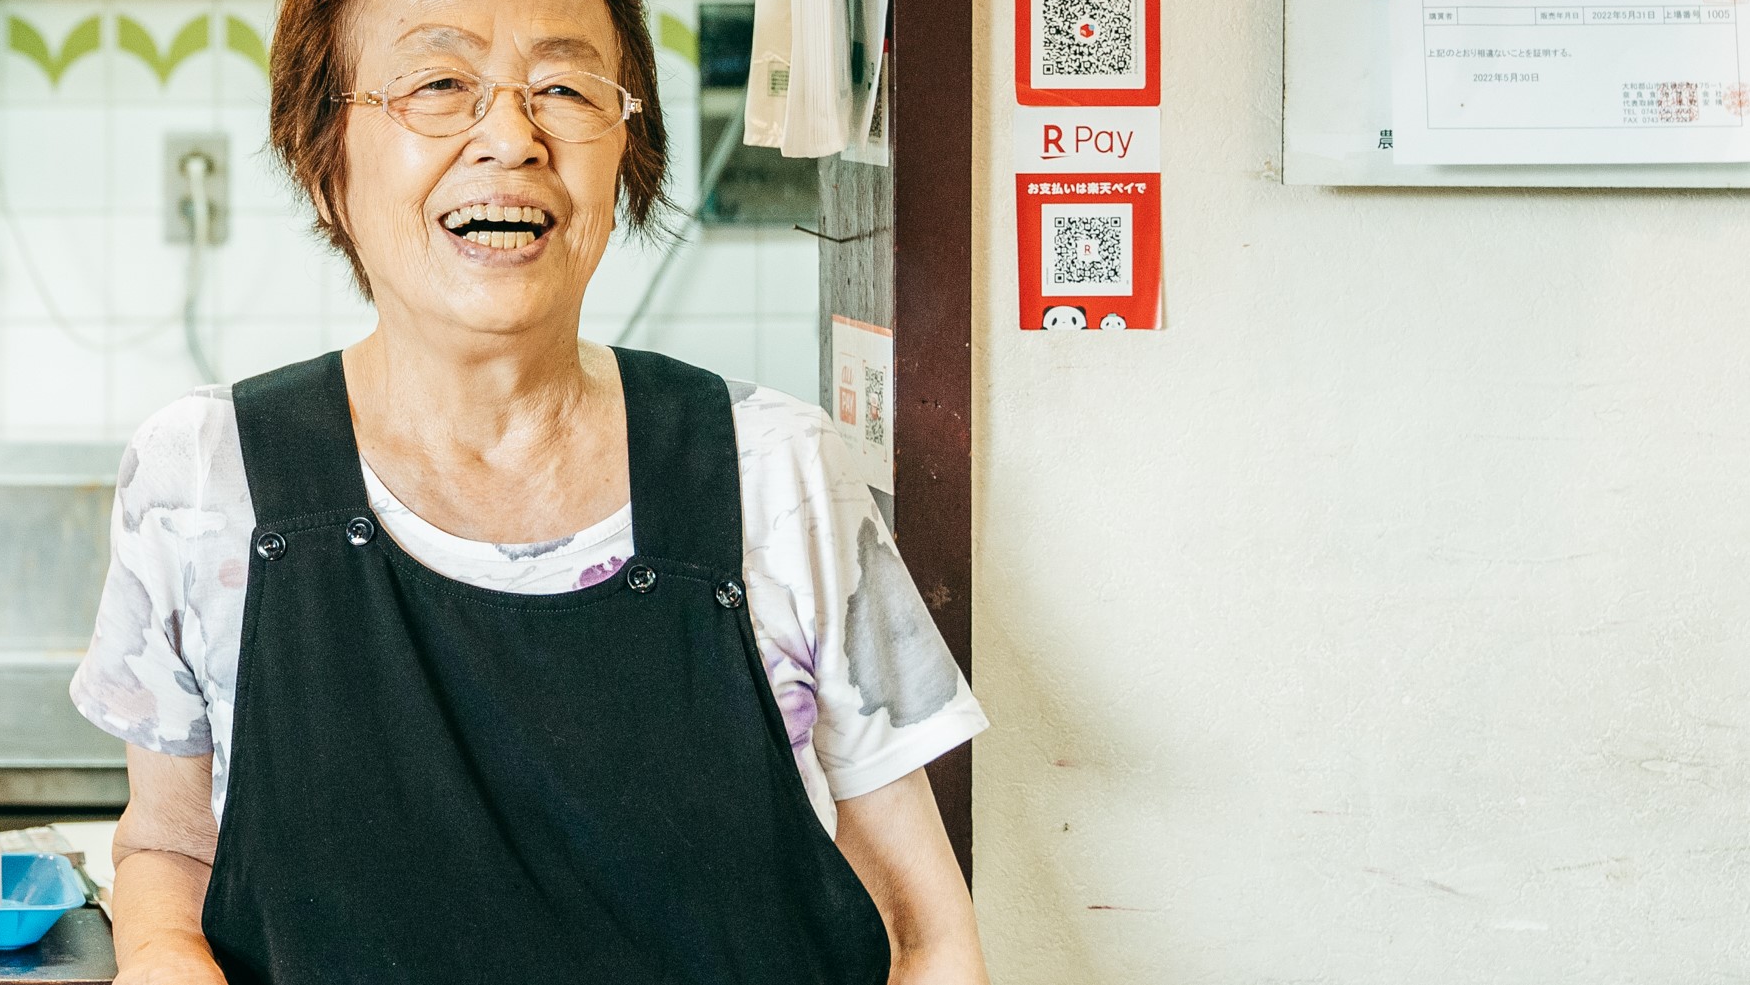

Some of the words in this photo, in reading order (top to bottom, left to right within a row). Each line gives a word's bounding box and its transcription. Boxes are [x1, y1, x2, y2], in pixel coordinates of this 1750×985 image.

[1592, 10, 1655, 20] 2022年5月31日
[1707, 9, 1730, 20] 1005
[1427, 47, 1572, 58] 上記のとおり相違ないことを証明する。
[1472, 72, 1540, 83] 2022年5月30日
[1043, 124, 1067, 155] R
[1075, 125, 1133, 158] Pay
[1027, 181, 1147, 196] お支払いは楽天ペイで
